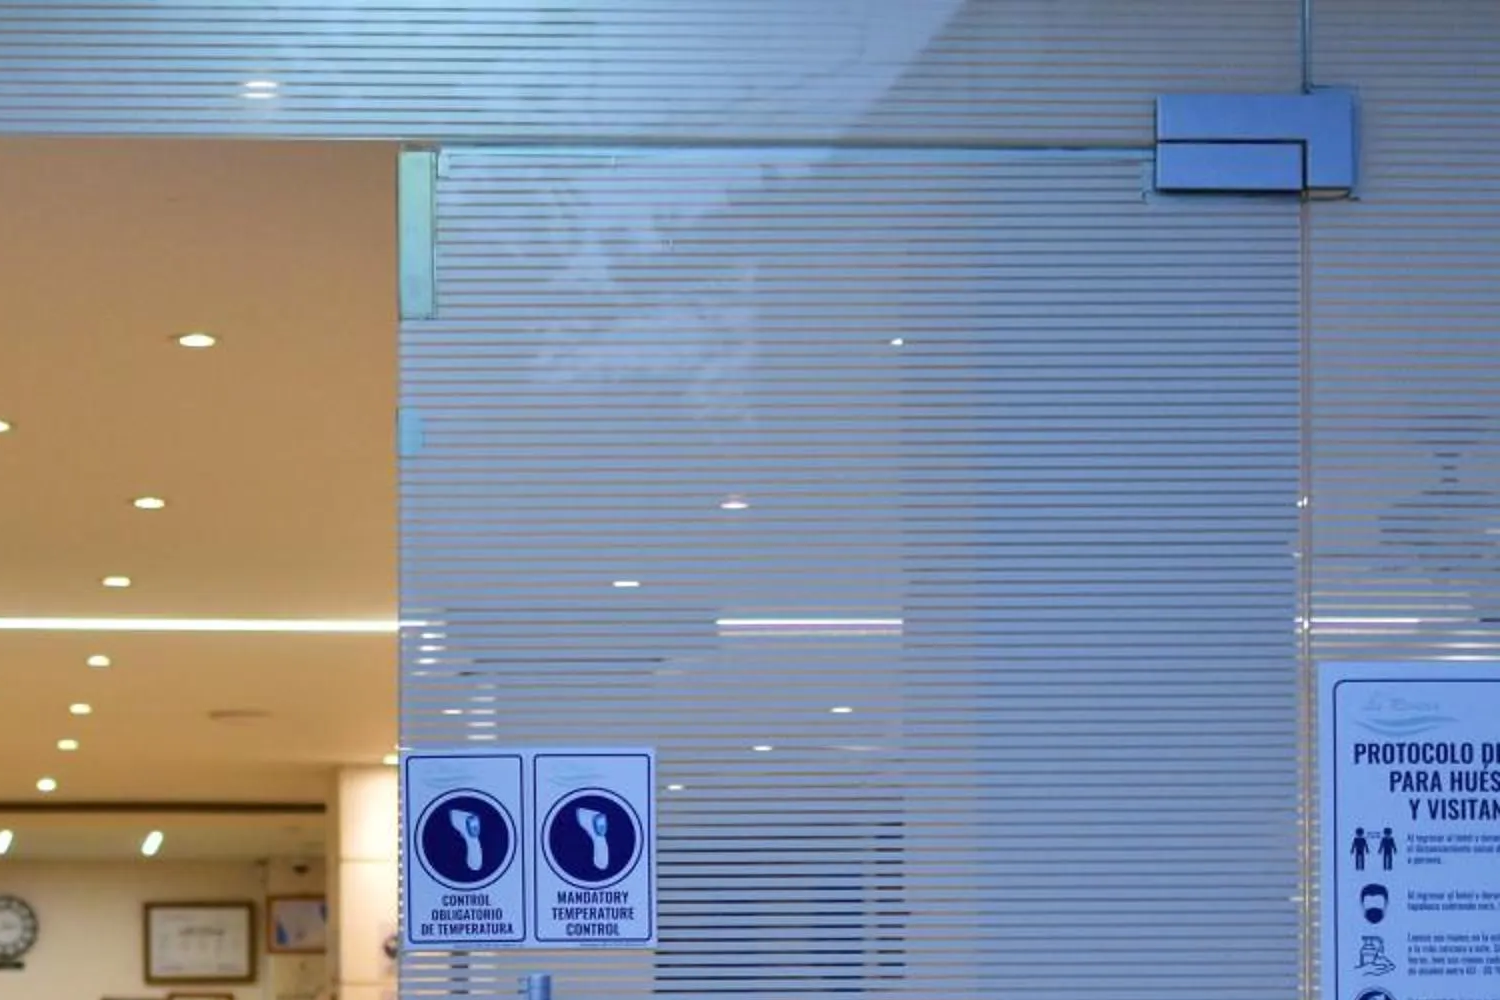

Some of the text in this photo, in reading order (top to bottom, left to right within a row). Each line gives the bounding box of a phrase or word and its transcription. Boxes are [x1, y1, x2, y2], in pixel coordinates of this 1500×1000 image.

[1354, 743, 1473, 765] PROTOCOLO
[1389, 770, 1443, 793] PARA
[1409, 798, 1421, 820] Y
[441, 894, 491, 907] CONTROL
[557, 891, 629, 904] MANDATORY
[431, 908, 503, 921] OBLIGATORIO
[552, 907, 634, 921] TEMPERATURE
[421, 922, 514, 936] DE TEMPERATURA
[566, 922, 620, 936] CONTROL
